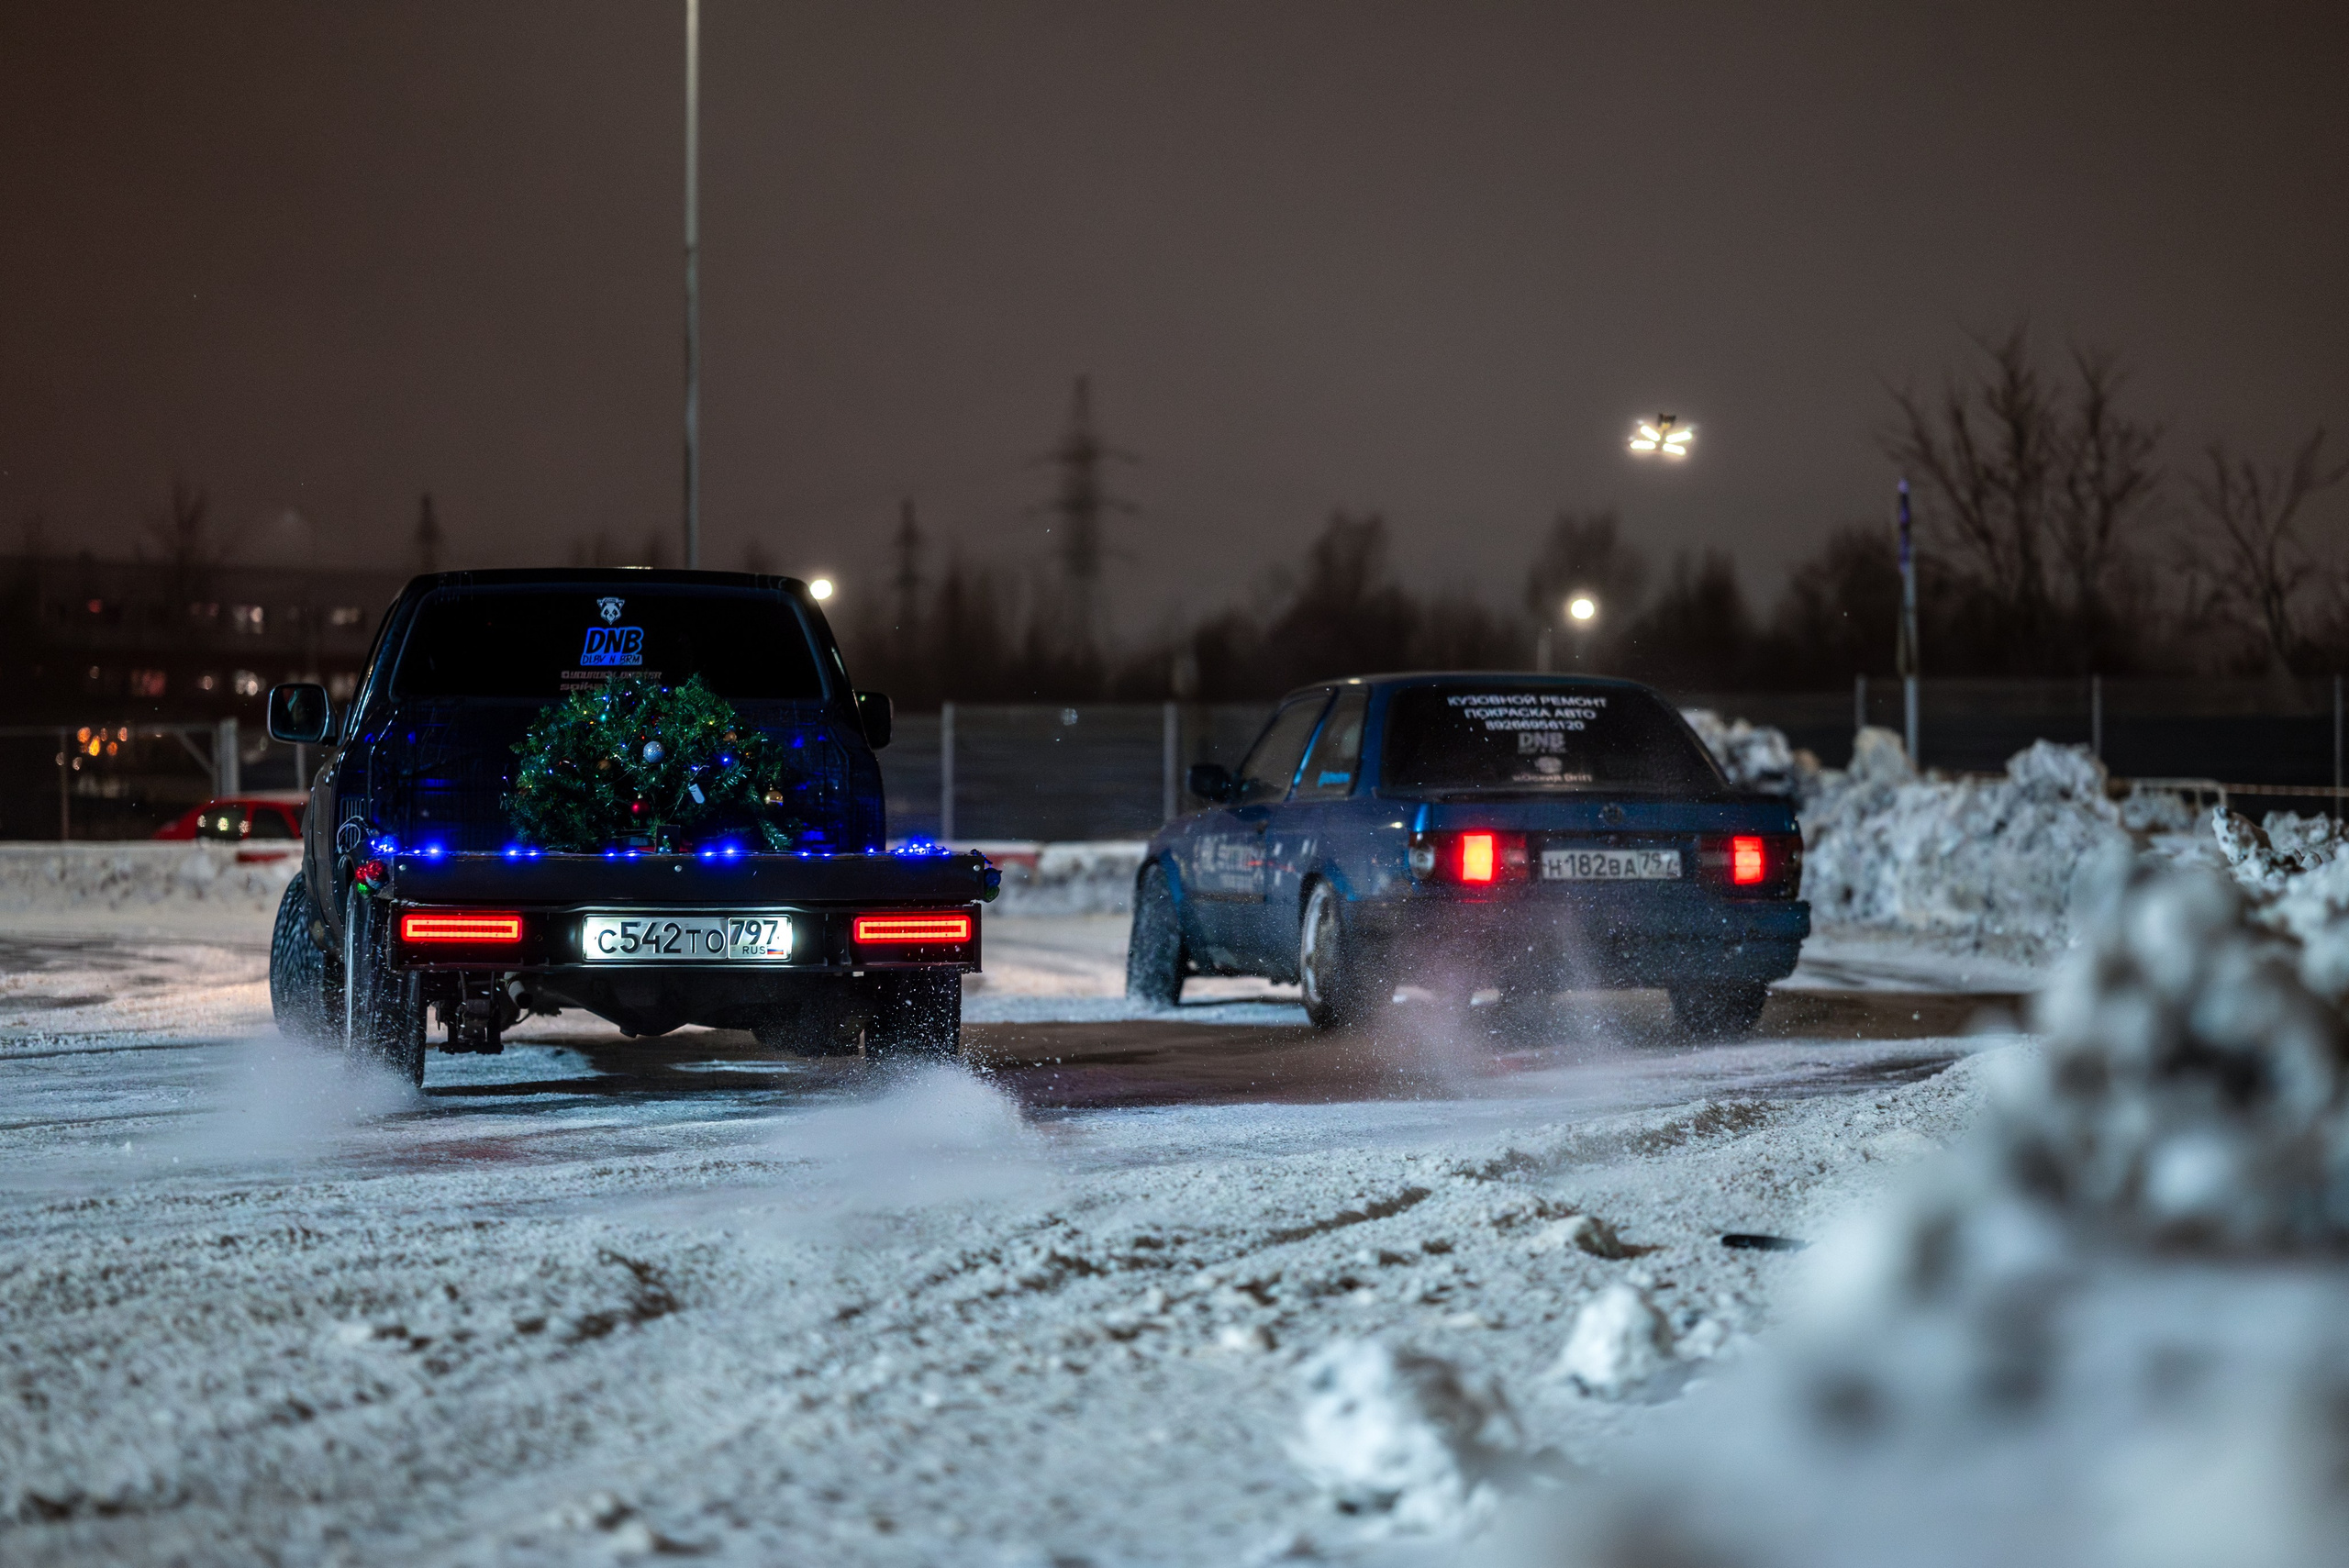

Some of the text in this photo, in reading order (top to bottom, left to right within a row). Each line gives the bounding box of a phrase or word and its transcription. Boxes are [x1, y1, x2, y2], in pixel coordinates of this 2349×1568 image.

[585, 628, 642, 654] DNB
[1447, 694, 1607, 707] КУЗОВНОЙ РЕМОНТ
[1464, 707, 1597, 719] ПОКРАСКА АВТО
[1547, 853, 1638, 876] Н182ВА
[598, 919, 779, 954] С542ТО 797
[742, 946, 766, 954] RUS
